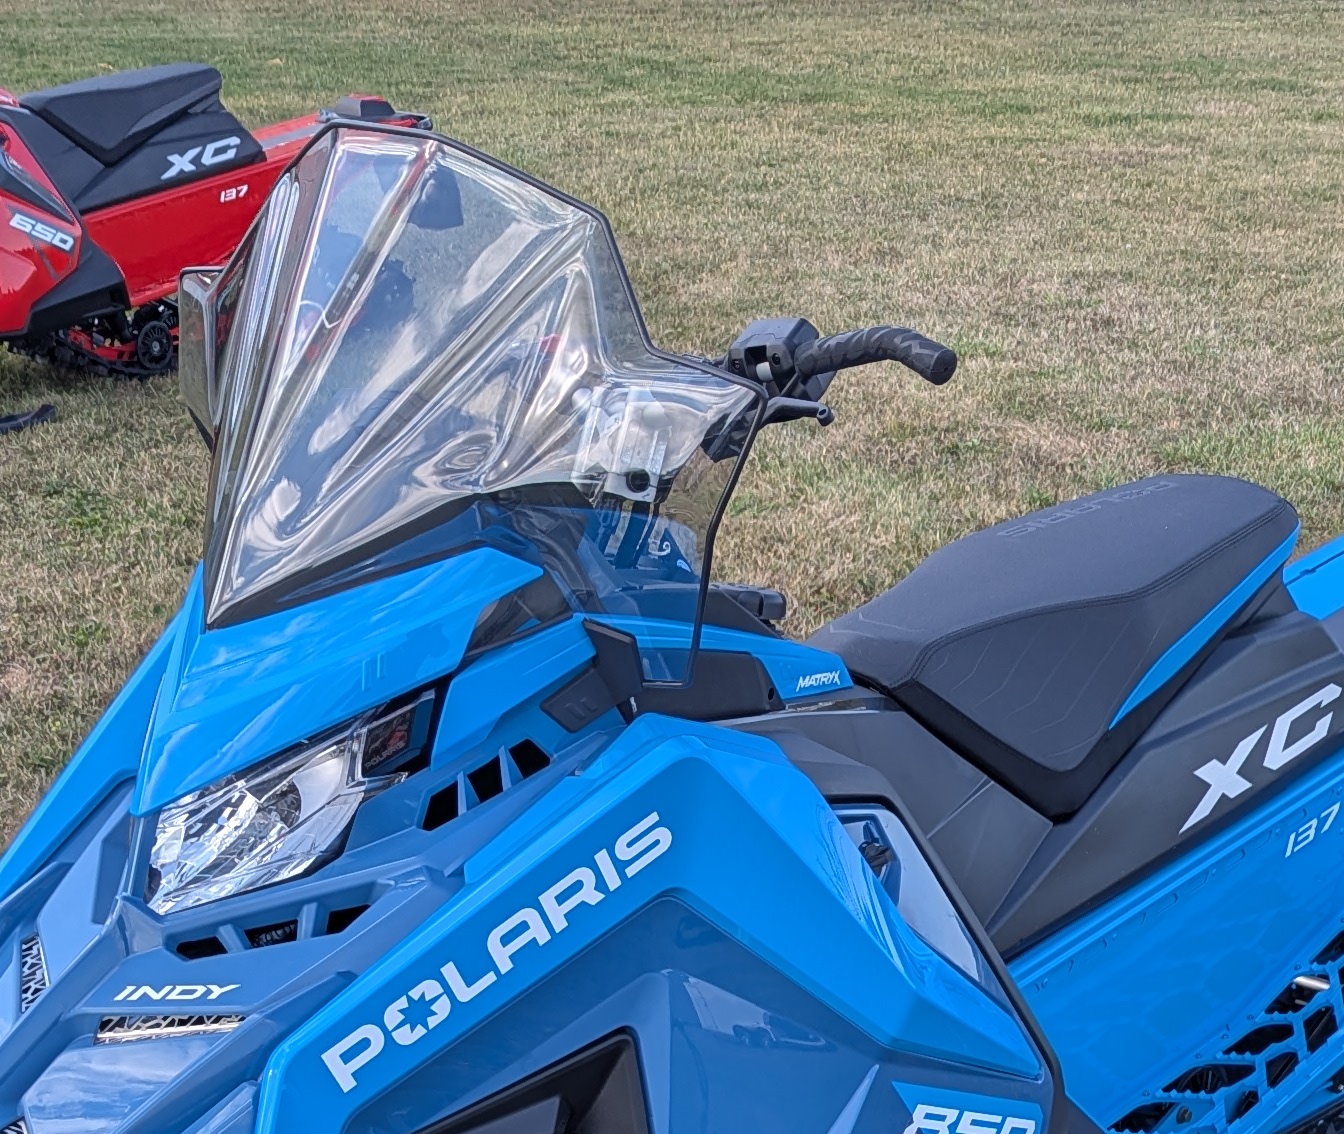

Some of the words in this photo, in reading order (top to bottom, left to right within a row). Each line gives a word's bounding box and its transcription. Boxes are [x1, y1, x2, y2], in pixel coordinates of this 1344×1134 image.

[160, 136, 241, 180] XC
[220, 184, 249, 203] 137
[9, 213, 74, 251] 650
[796, 670, 840, 692] MATRYX
[1178, 683, 1343, 835] XC
[1285, 801, 1341, 858] 137
[320, 811, 673, 1093] POLARIS
[113, 984, 241, 1001] INDY
